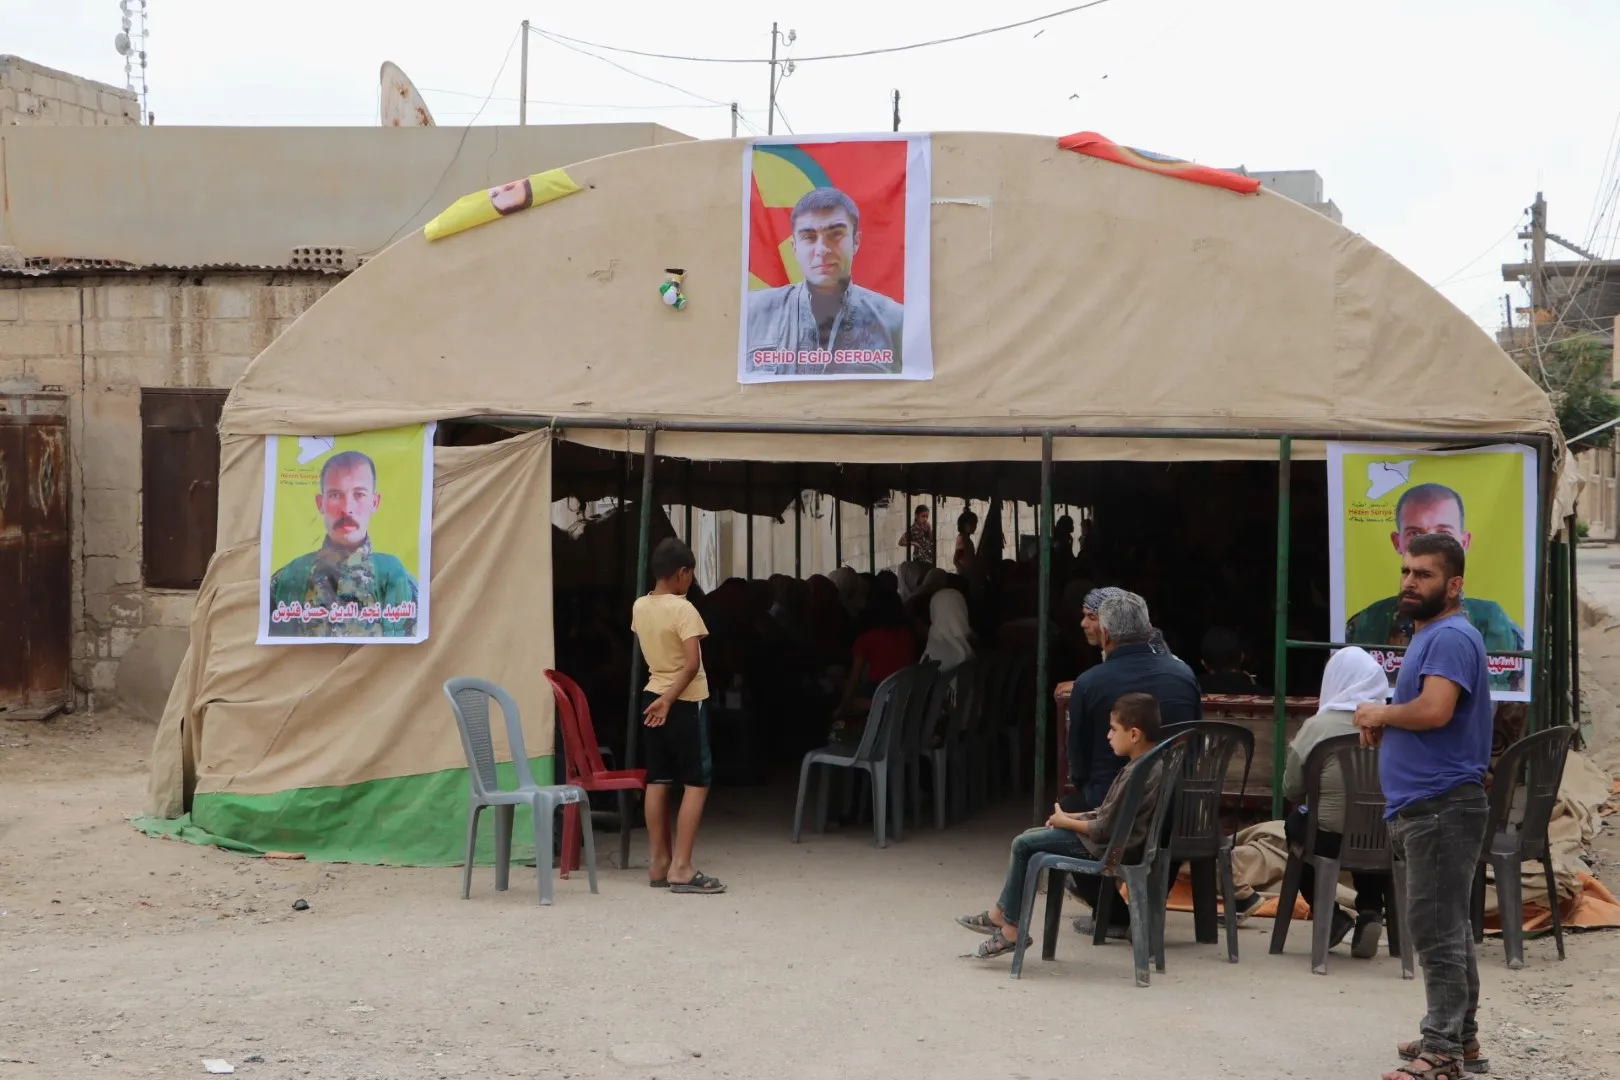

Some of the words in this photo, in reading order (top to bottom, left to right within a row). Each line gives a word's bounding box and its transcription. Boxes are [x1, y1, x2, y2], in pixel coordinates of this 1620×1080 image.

[834, 349, 893, 363] SERDAR
[301, 601, 329, 623] حسن
[329, 601, 359, 623] الدين
[358, 602, 381, 624] نجم
[382, 601, 416, 622] الشهيد
